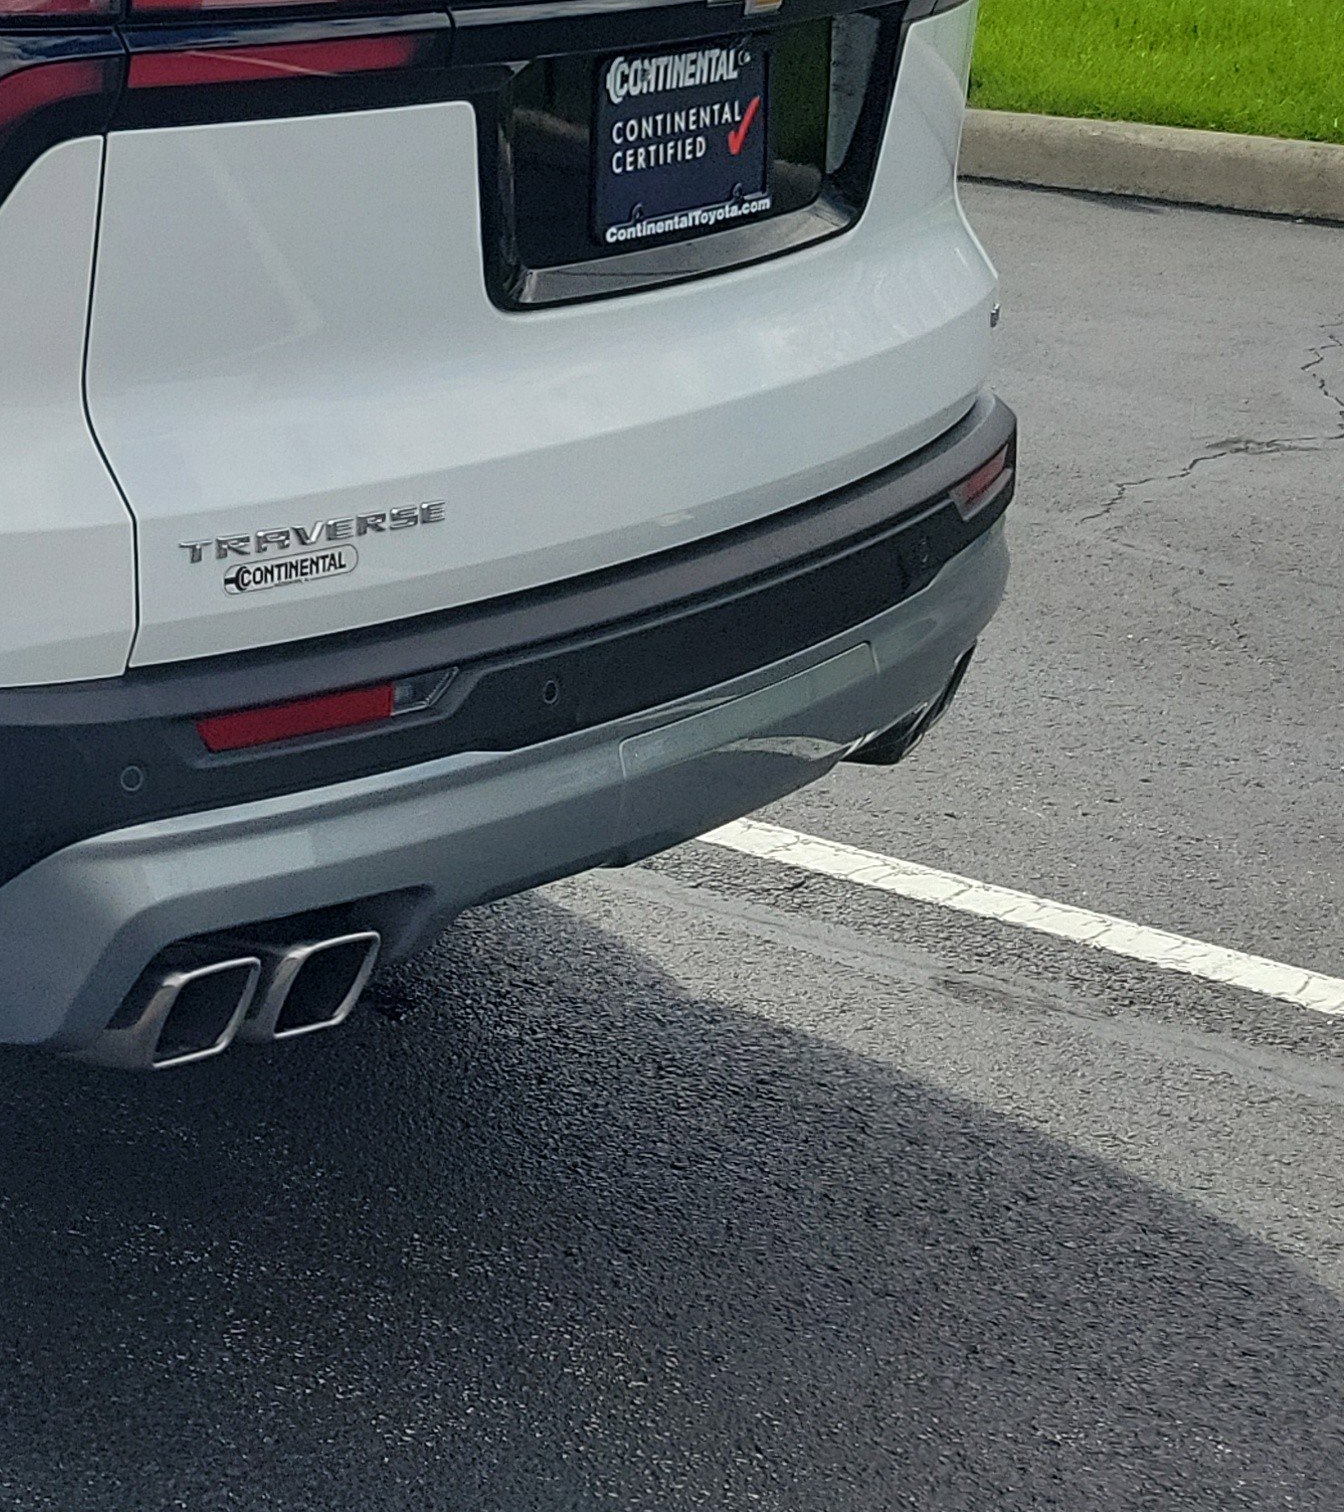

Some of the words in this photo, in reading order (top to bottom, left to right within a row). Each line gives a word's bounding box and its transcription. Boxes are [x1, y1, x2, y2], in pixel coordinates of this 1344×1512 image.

[611, 48, 739, 99] CONTINENTAL
[612, 100, 742, 144] CONTINENTAL
[612, 136, 706, 174] CERTIFIED
[605, 196, 772, 243] ContinentalToyota.com
[178, 499, 446, 564] TRAVERSE
[240, 551, 346, 587] CONTINENTAL
